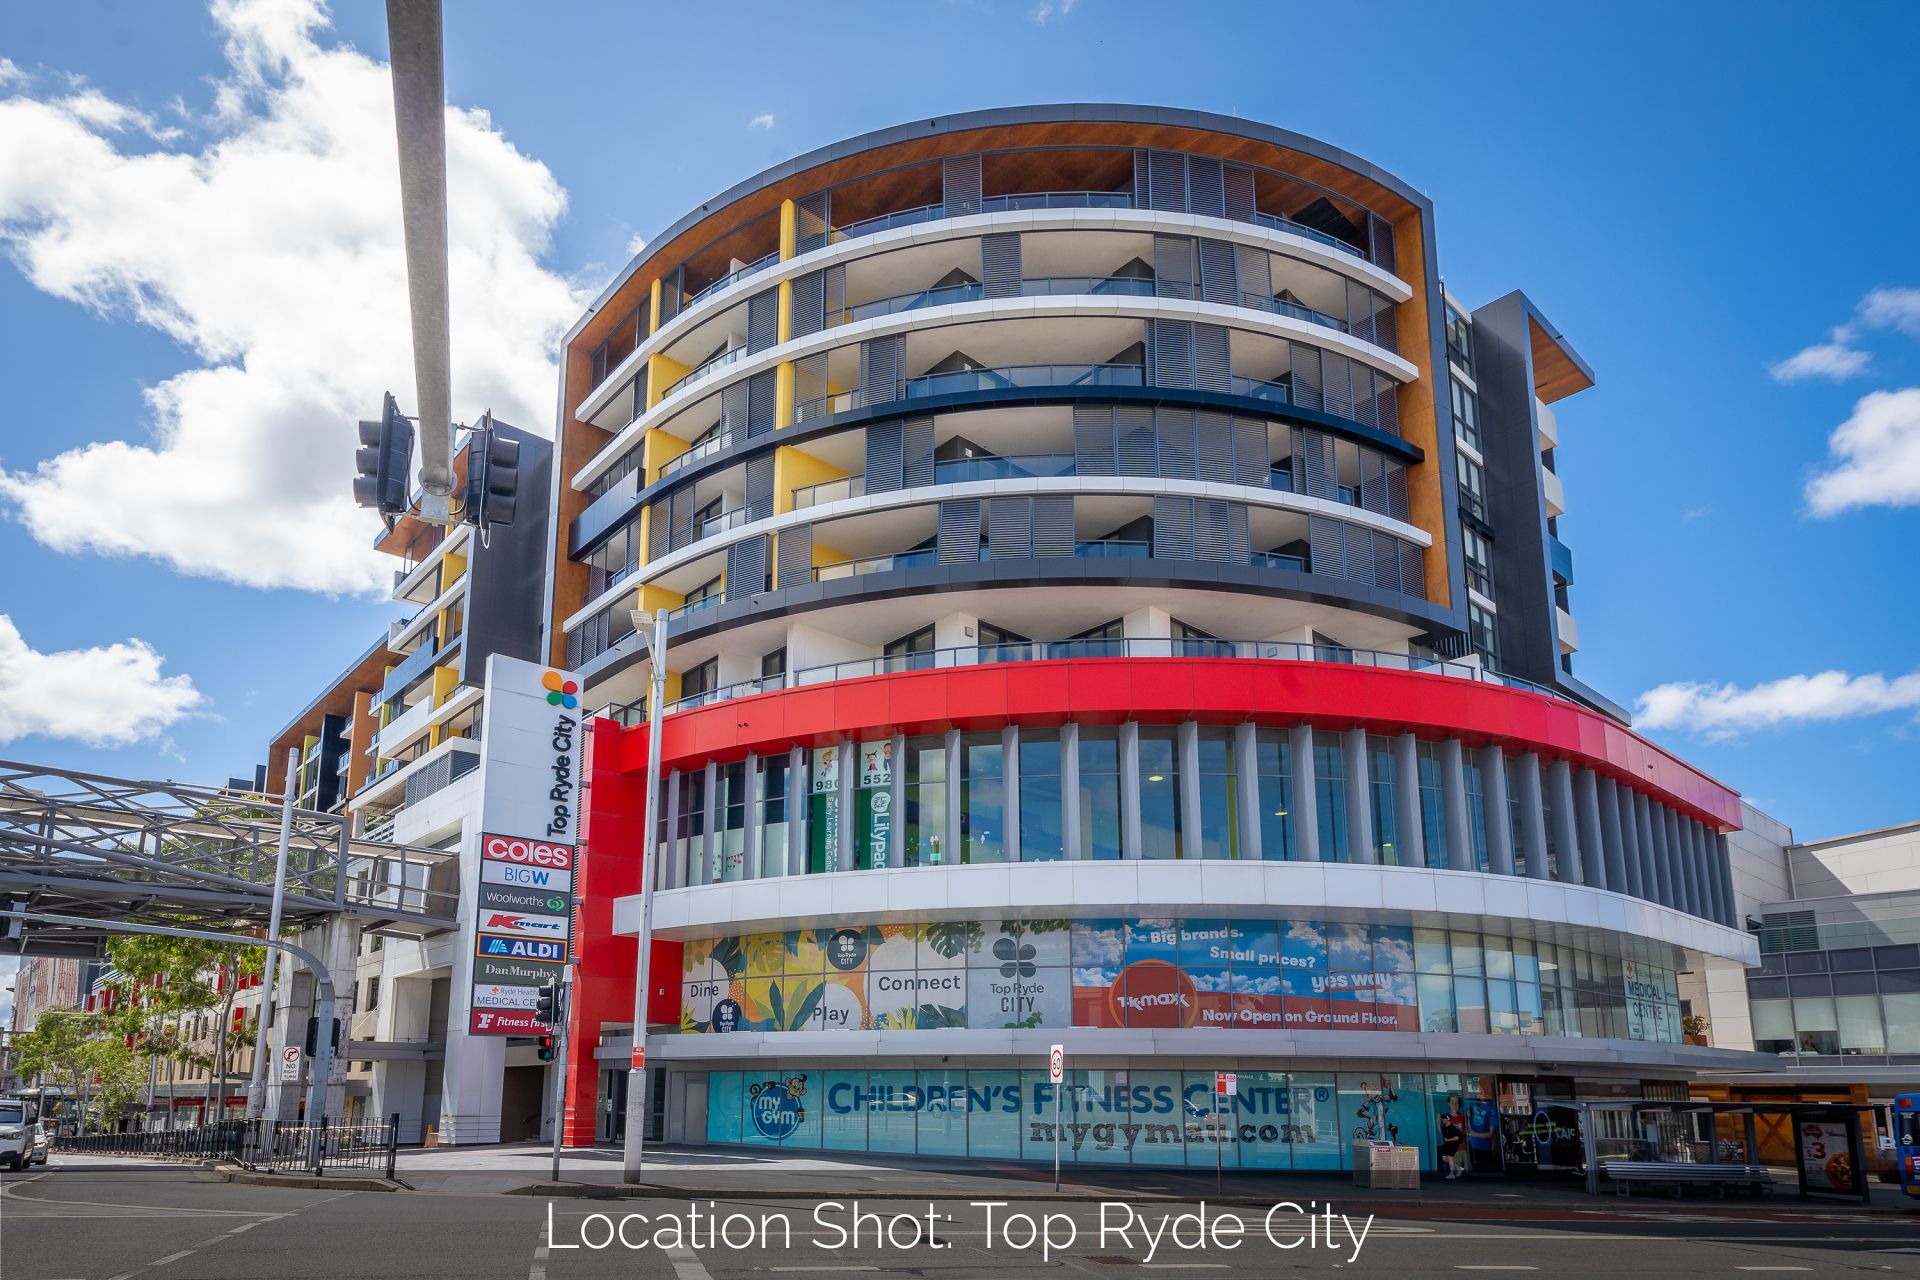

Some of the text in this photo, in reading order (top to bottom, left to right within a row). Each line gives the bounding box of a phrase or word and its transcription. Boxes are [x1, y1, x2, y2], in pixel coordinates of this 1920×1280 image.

[547, 715, 576, 836] Top Ryde City
[864, 774, 890, 784] 552
[487, 891, 543, 906] Woolworths
[487, 914, 560, 930] Kmart
[1151, 927, 1244, 945] Big brands.
[511, 941, 558, 958] ALDI
[1210, 946, 1315, 968] Small prices?
[485, 964, 557, 980] Dan Murphy's
[690, 984, 719, 997] Dine
[879, 975, 960, 991] Connect
[990, 983, 1044, 996] Top Ryde
[1312, 975, 1348, 993] yes
[1628, 981, 1662, 1000] MEDICAL
[477, 997, 520, 1005] MEDICAL
[1001, 997, 1035, 1012] CITY
[813, 1006, 849, 1025] Play
[1203, 1009, 1397, 1024] Now Open on Ground Floor.
[1633, 1002, 1662, 1020] CENTRE
[1053, 1058, 1060, 1069] 60
[1033, 1083, 1174, 1115] FITNESS
